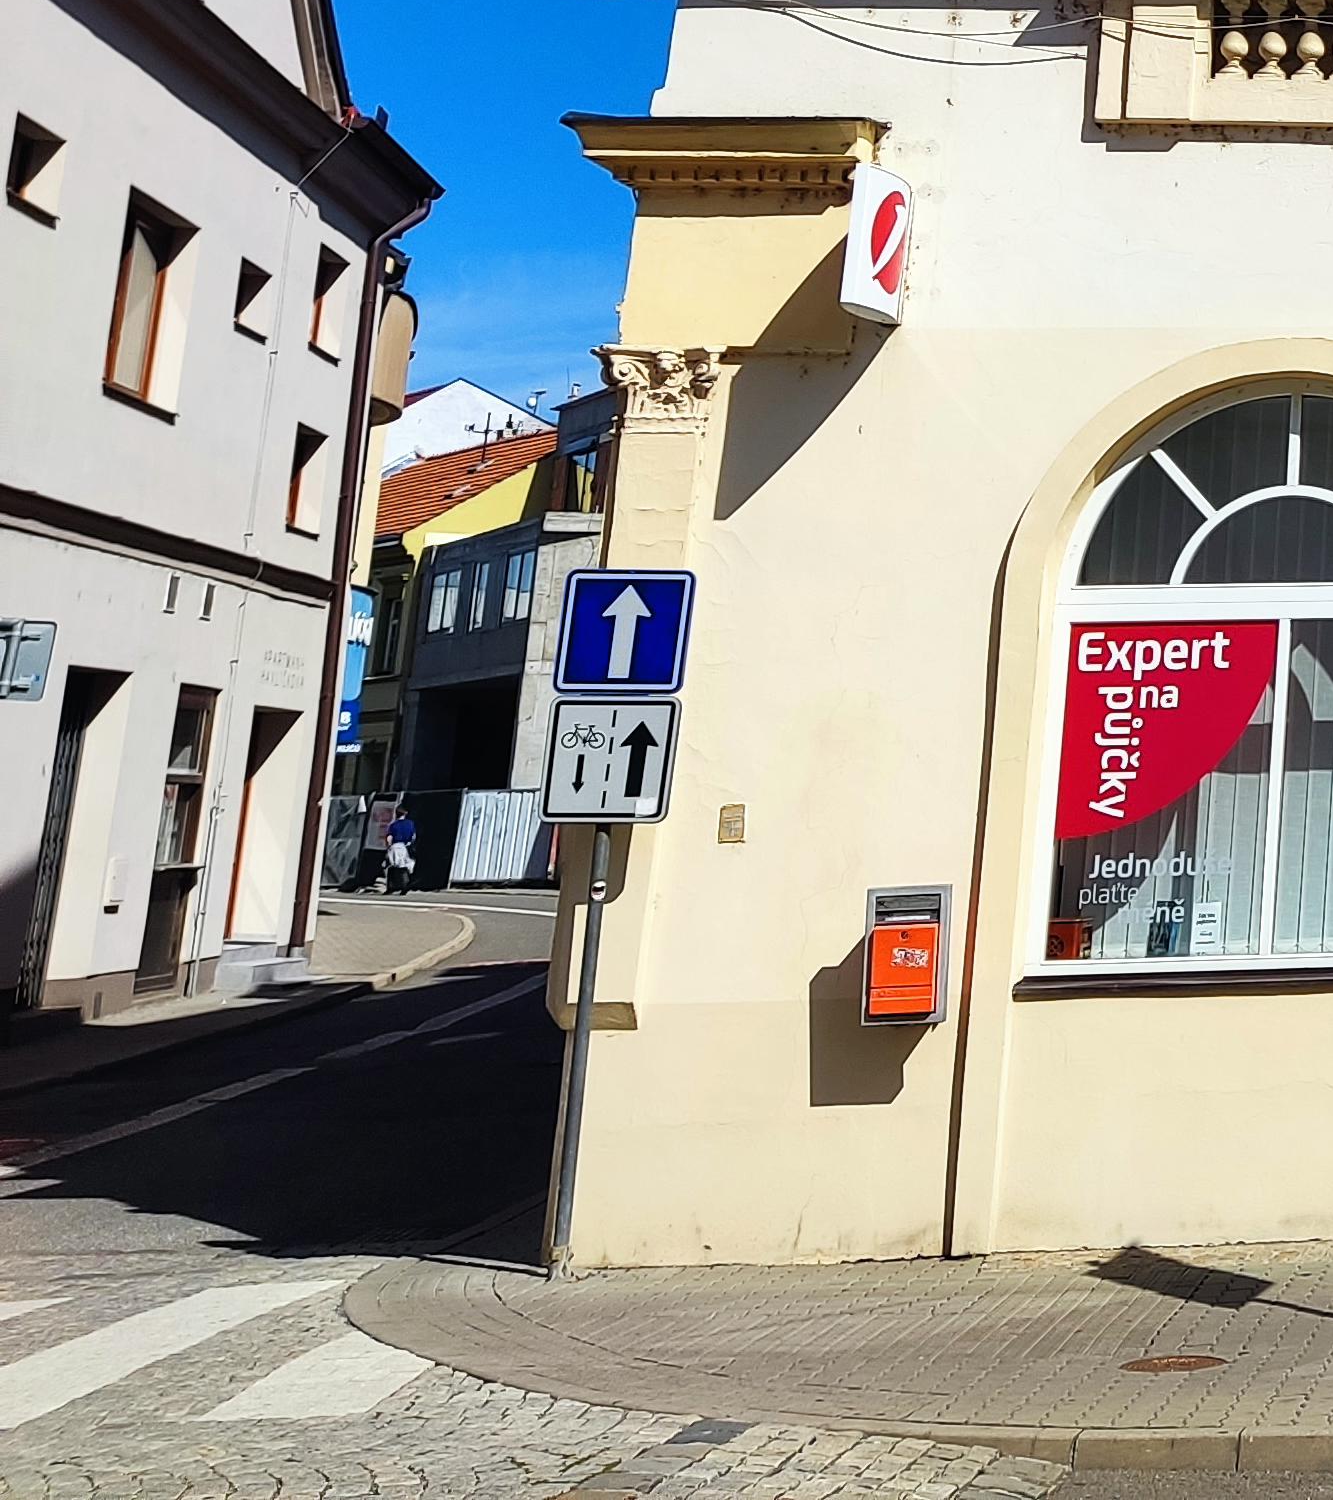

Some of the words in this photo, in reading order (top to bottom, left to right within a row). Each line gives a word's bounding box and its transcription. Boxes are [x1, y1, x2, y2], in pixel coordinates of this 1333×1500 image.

[1077, 631, 1231, 680] Expert
[1139, 685, 1179, 709] na
[1088, 686, 1143, 818] půjčky
